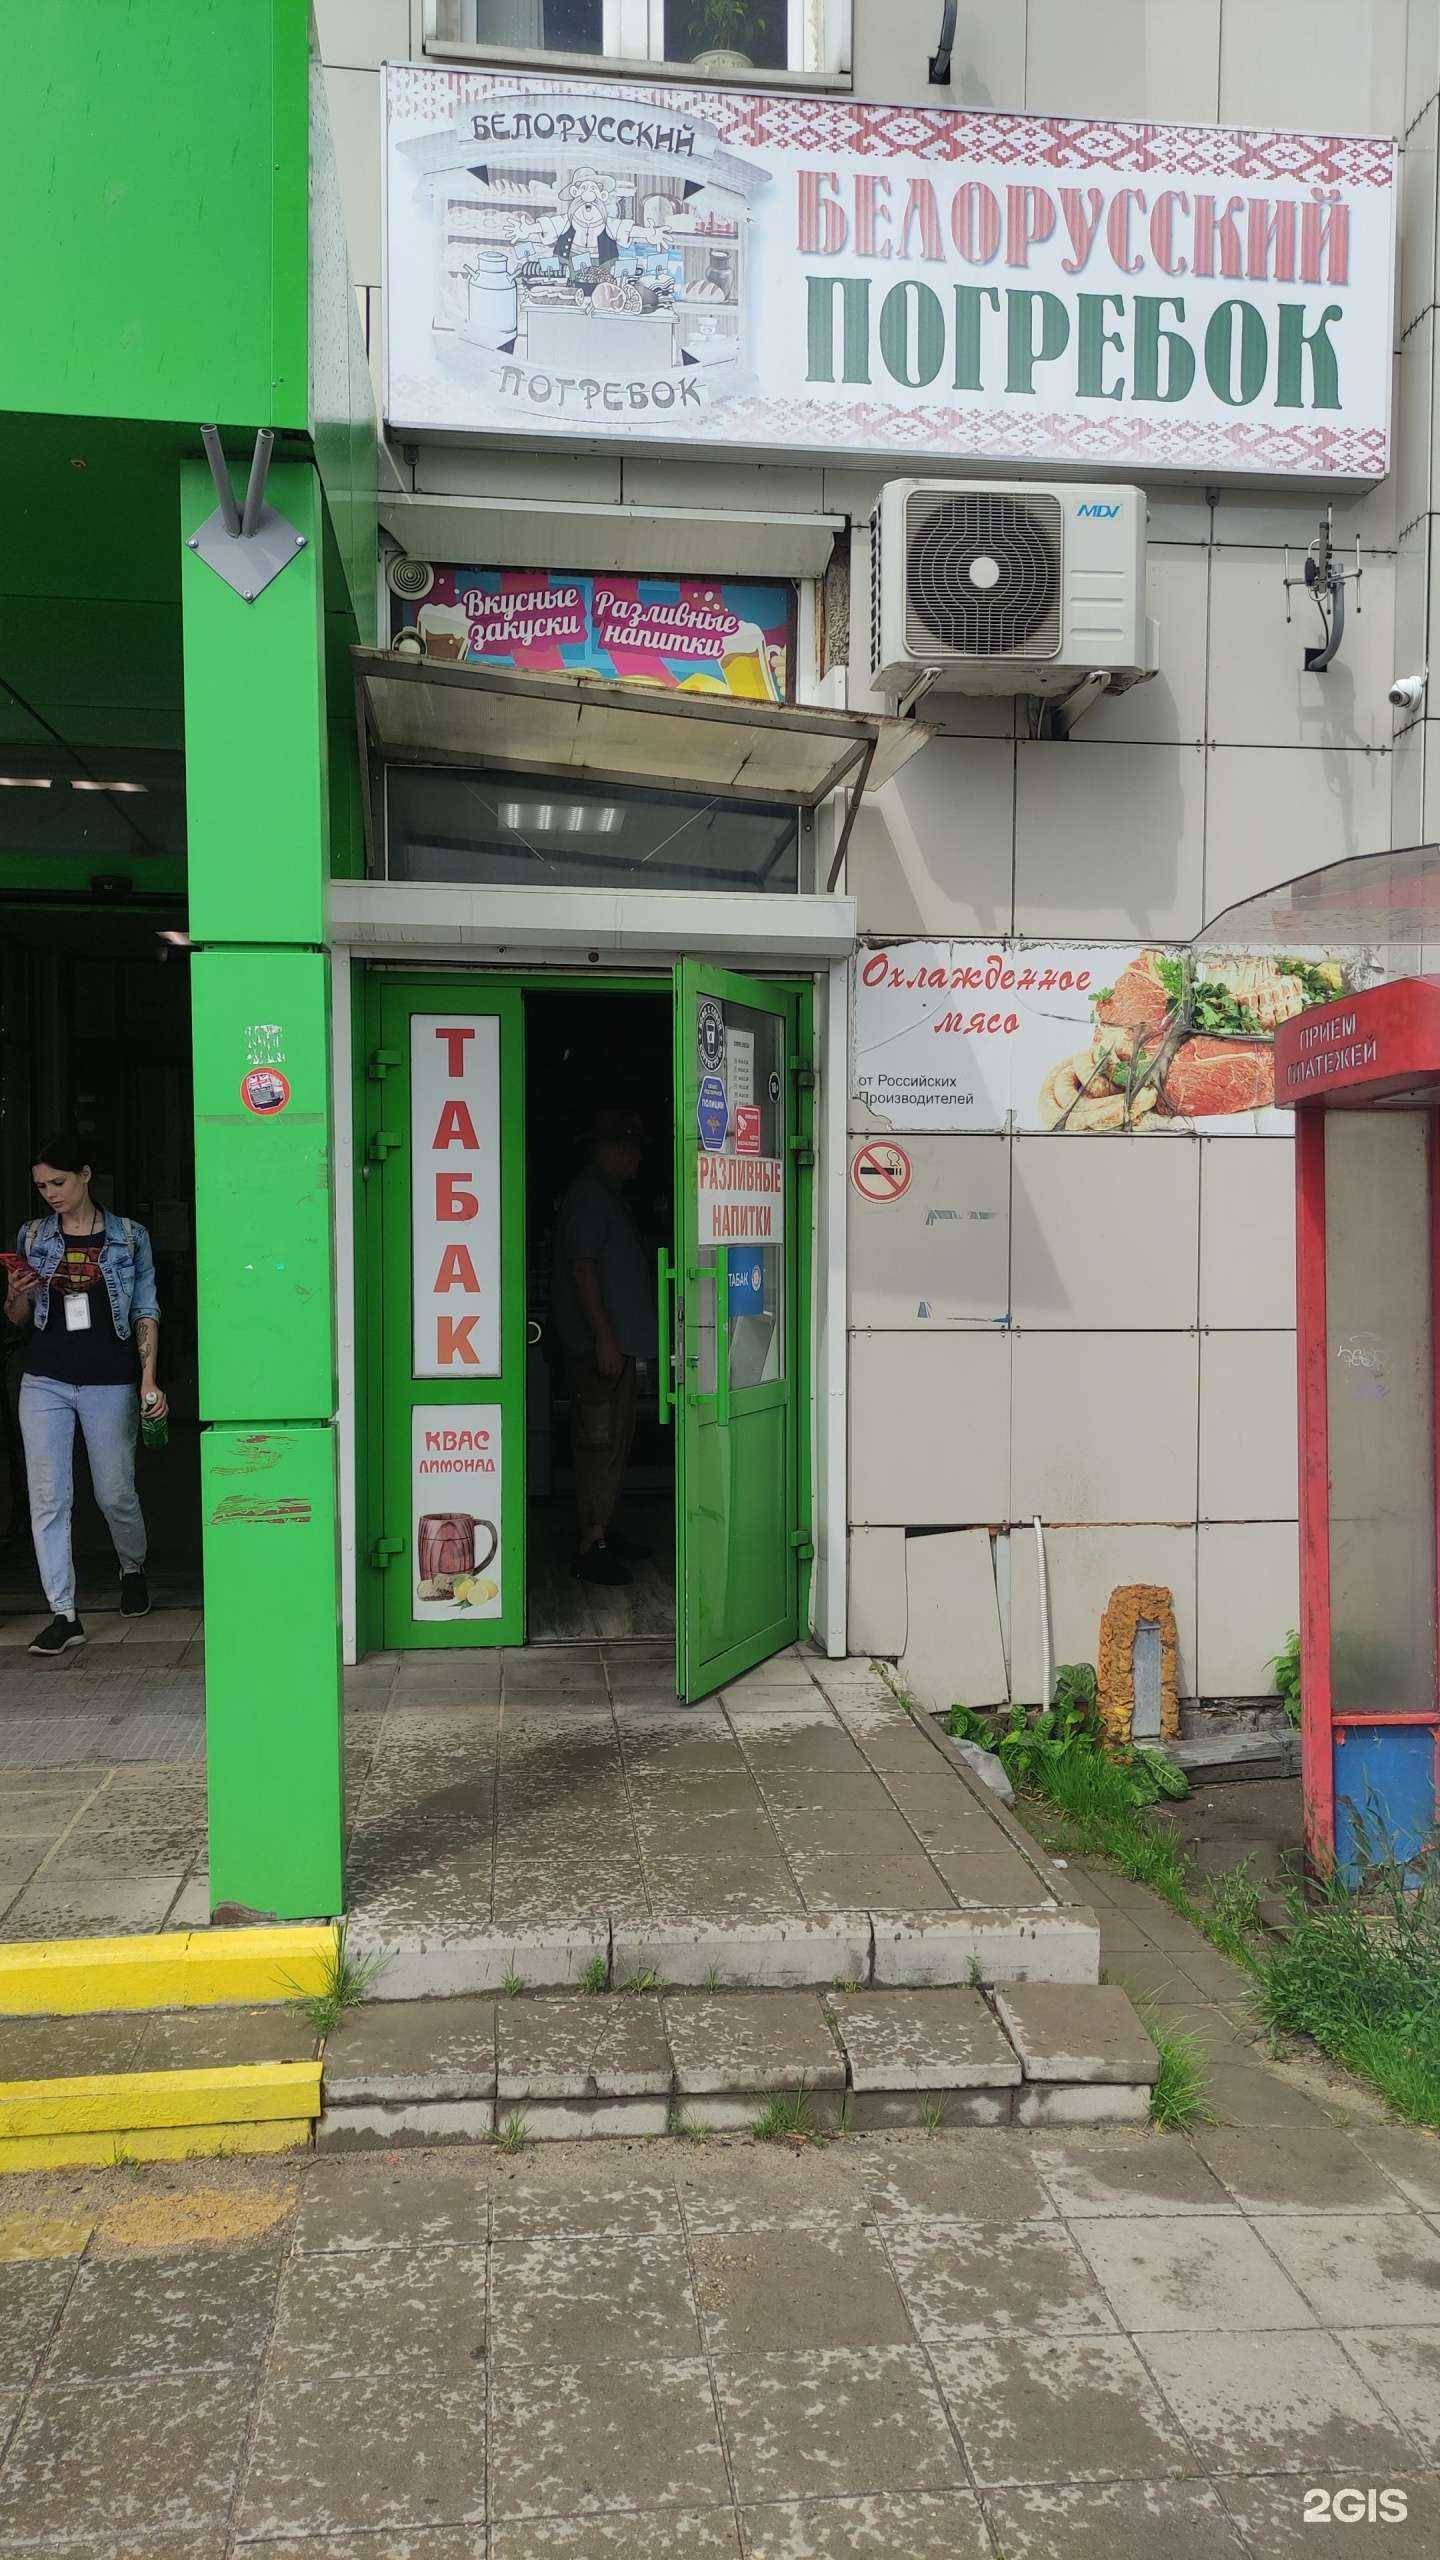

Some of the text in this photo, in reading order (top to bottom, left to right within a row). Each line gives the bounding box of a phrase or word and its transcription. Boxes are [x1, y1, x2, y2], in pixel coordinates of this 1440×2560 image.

[470, 112, 696, 157] БЕЛОРУССКИЙ
[795, 169, 1352, 287] БЕЛОРУССКИЙ
[804, 276, 1344, 410] ПОГРЕБОК
[498, 365, 701, 411] ПОГРЕБОК
[1076, 504, 1121, 518] MDV
[463, 588, 579, 620] Вкусные
[595, 590, 740, 634] Разливные
[469, 613, 581, 651] закуски
[602, 622, 725, 659] напитки
[862, 952, 1092, 992] Охлажденное
[934, 1010, 1020, 1035] мясо
[1299, 1012, 1358, 1051] ПРИЕМ
[1286, 1034, 1378, 1086] ПЛАТЕЖЕЙ
[858, 1073, 958, 1088] от Российских
[858, 1091, 975, 1107] Производителей
[700, 1156, 781, 1193] РАЗЛИВНЫЕ
[432, 1028, 481, 1365] ТАБАК
[712, 1204, 772, 1237] НАПИТКИ
[728, 1271, 749, 1287] ТАБАК
[425, 1430, 490, 1451] КВАС
[419, 1458, 496, 1474] ЛИМОНАД
